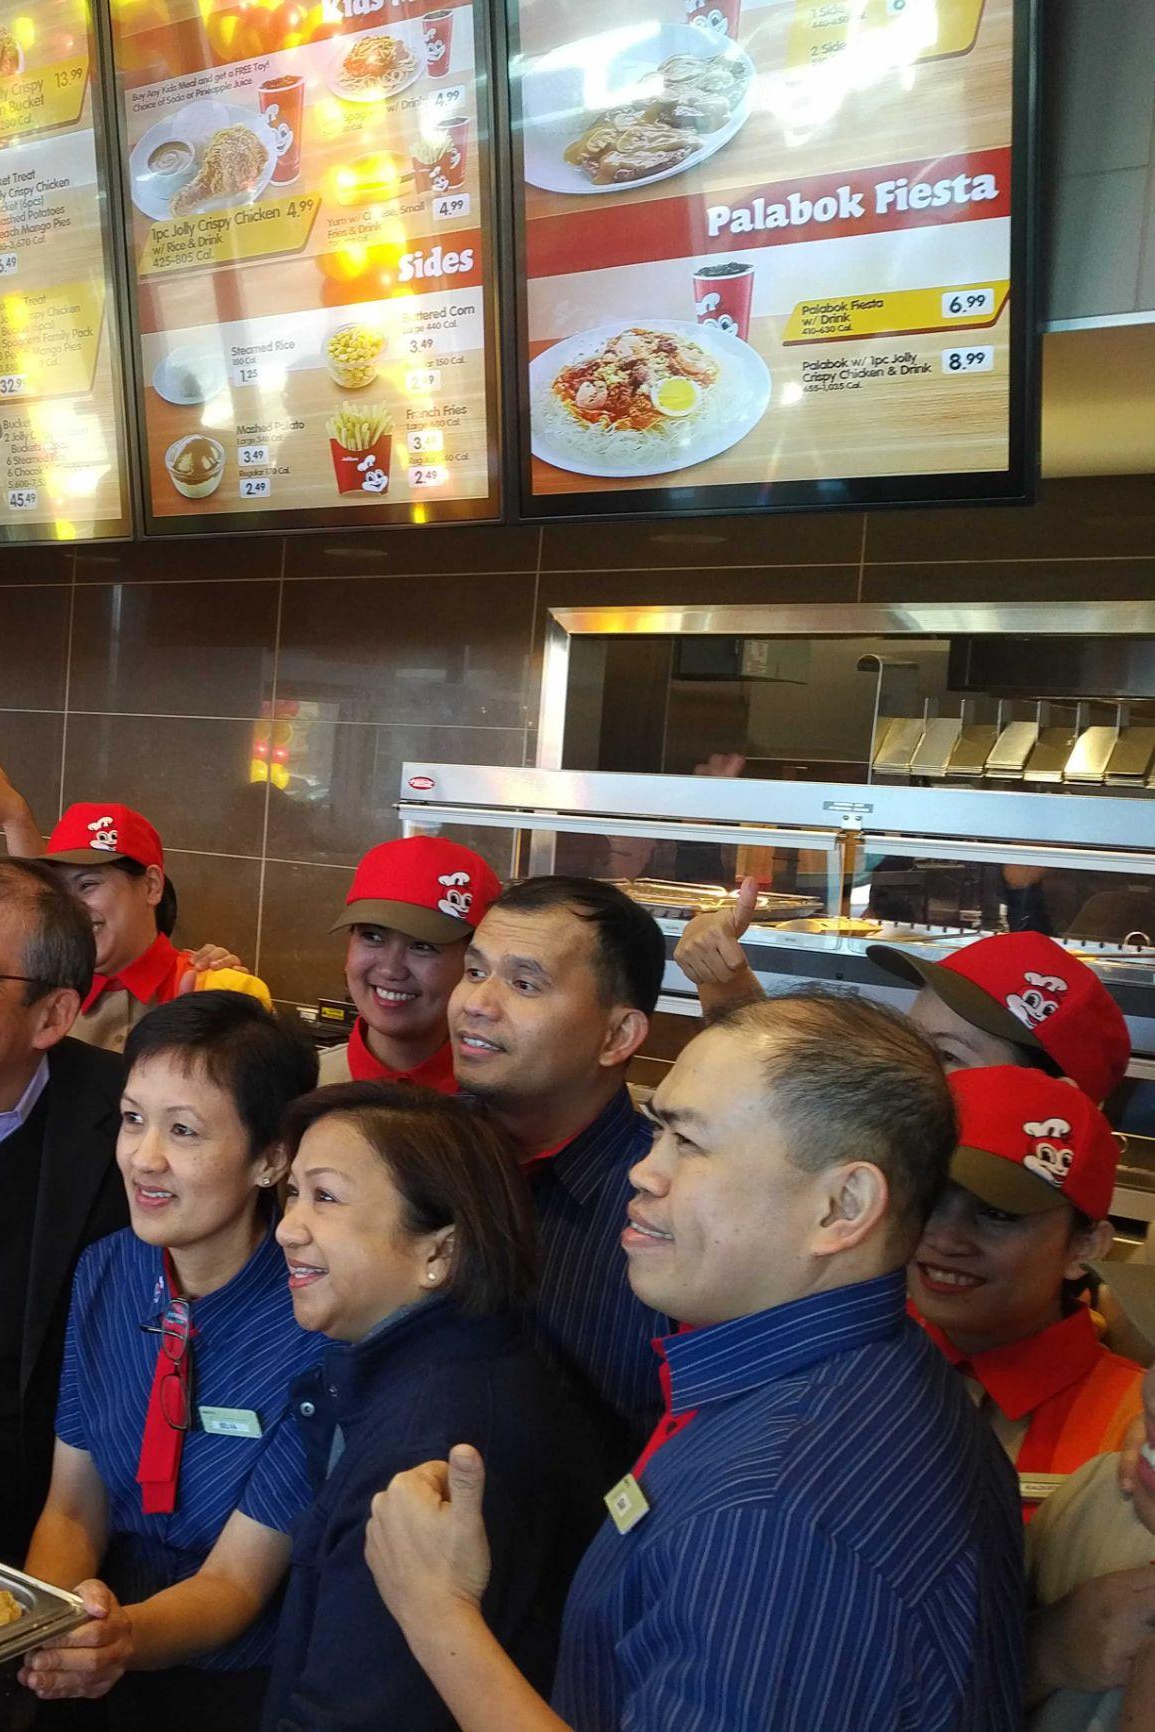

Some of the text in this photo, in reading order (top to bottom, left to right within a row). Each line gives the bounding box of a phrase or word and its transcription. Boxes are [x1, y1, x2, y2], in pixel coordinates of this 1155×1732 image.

[810, 46, 819, 57] 2
[12, 68, 83, 96] Crispy 13.99
[178, 78, 197, 91] Meal
[198, 74, 213, 86] and
[235, 64, 252, 77] FREE
[9, 94, 45, 112] Bucket
[133, 100, 157, 113] Choice
[166, 94, 185, 106] Soda
[186, 92, 194, 101] or
[195, 81, 233, 99] Pineapple
[233, 78, 254, 89] Juice
[434, 89, 460, 107] 4.99
[12, 169, 36, 182] Treat
[8, 186, 34, 199] Crispy
[36, 178, 70, 192] Chicken
[707, 173, 1000, 237] Palabok Fiesta
[28, 206, 66, 220] Potatoes
[152, 198, 314, 243] 1pc Jolly Crispy Chicken 4.99
[327, 214, 347, 228] Yum
[400, 201, 426, 216] Small
[439, 199, 464, 216] 4.99
[21, 221, 52, 234] Mango
[53, 217, 71, 229] Pies
[350, 226, 358, 236] &
[359, 222, 382, 234] Drink
[152, 234, 224, 255] w/ Rice & Drink
[398, 246, 474, 282] Sides
[23, 295, 47, 305] Treat
[802, 294, 986, 316] Palabok Fiesta 6.99
[449, 305, 475, 317] Corn
[802, 312, 851, 327] w/ Drink
[72, 327, 94, 338] Pack
[64, 342, 82, 352] Pies
[231, 339, 295, 357] Steamed Rice
[410, 338, 434, 353] 3.49
[803, 352, 918, 371] Palabok w/ 1pc Jolly
[803, 352, 986, 383] Crispy Chicken & Drink 8.99
[240, 369, 258, 383] 1.25
[443, 403, 468, 417] Fries
[2, 418, 31, 430] Bucket
[237, 422, 273, 435] Mashed
[5, 433, 10, 442] 2
[12, 431, 29, 443] Jolly
[6, 457, 12, 466] 6
[244, 450, 264, 463] 3.49
[7, 469, 13, 478] 6
[414, 470, 438, 485] 2.49
[246, 482, 266, 495] 2.49
[10, 493, 36, 507] 45.49
